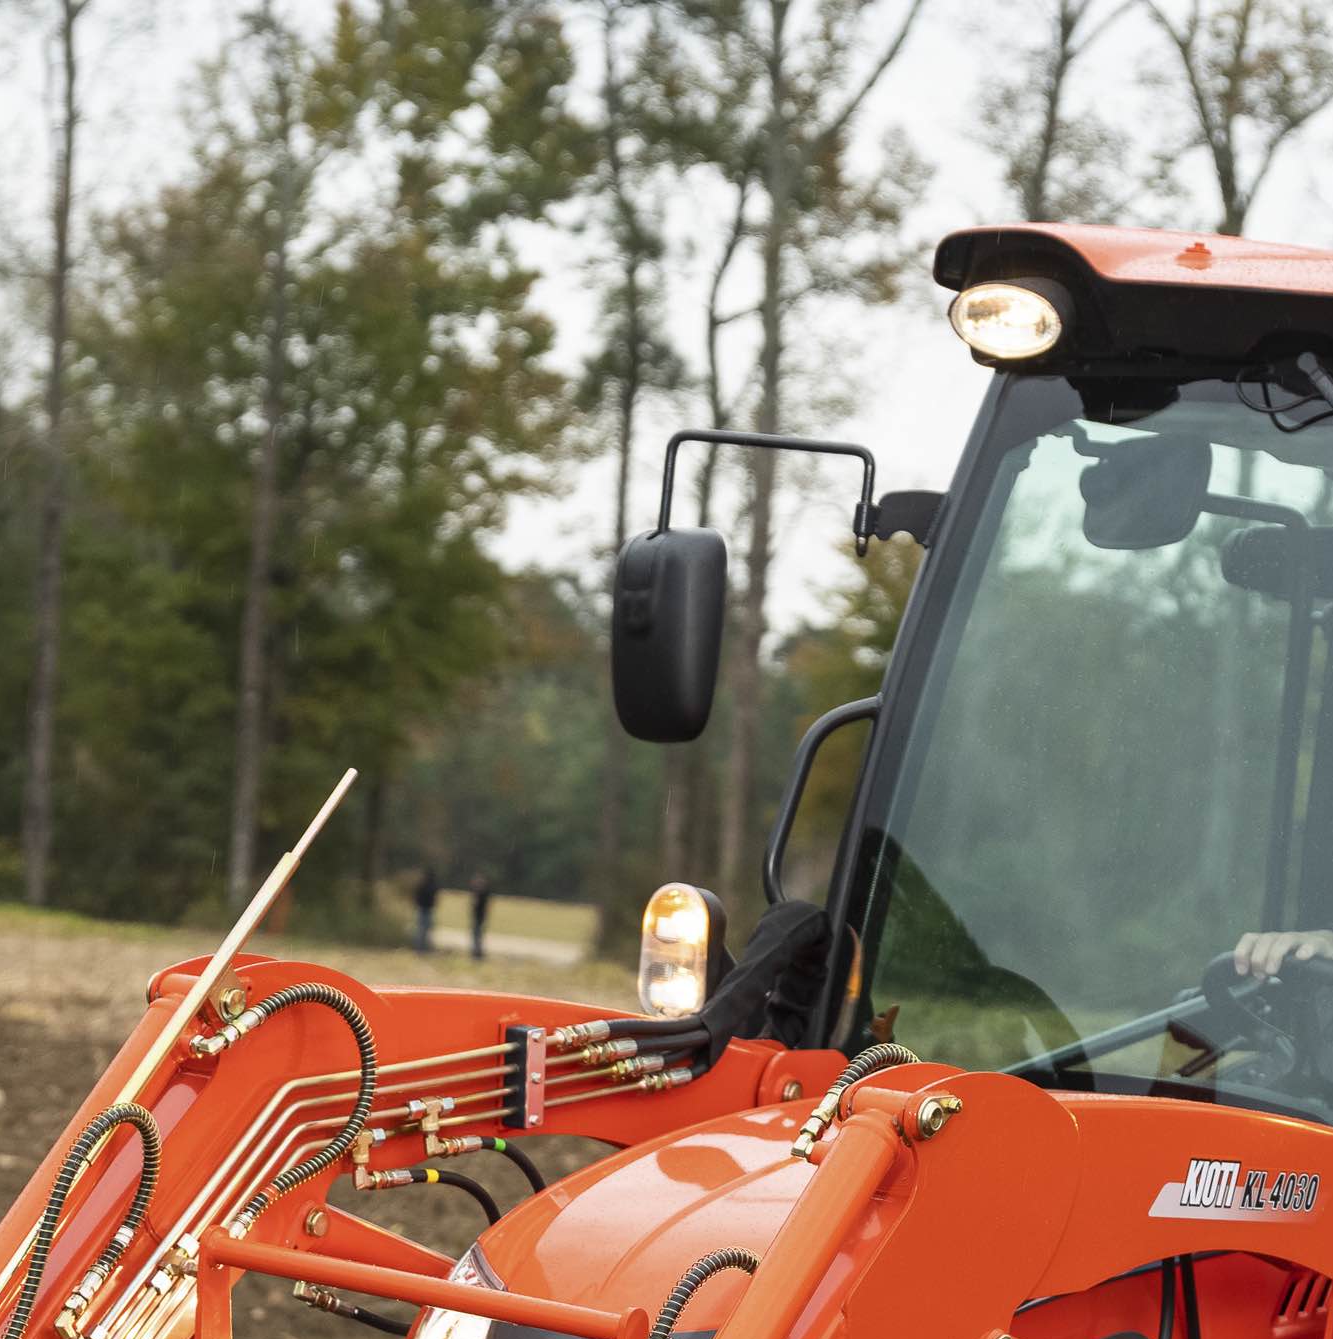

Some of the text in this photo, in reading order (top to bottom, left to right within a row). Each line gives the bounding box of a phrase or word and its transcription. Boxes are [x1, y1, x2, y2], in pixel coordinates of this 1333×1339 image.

[1180, 1158, 1319, 1212] KIOTI KL 4030
